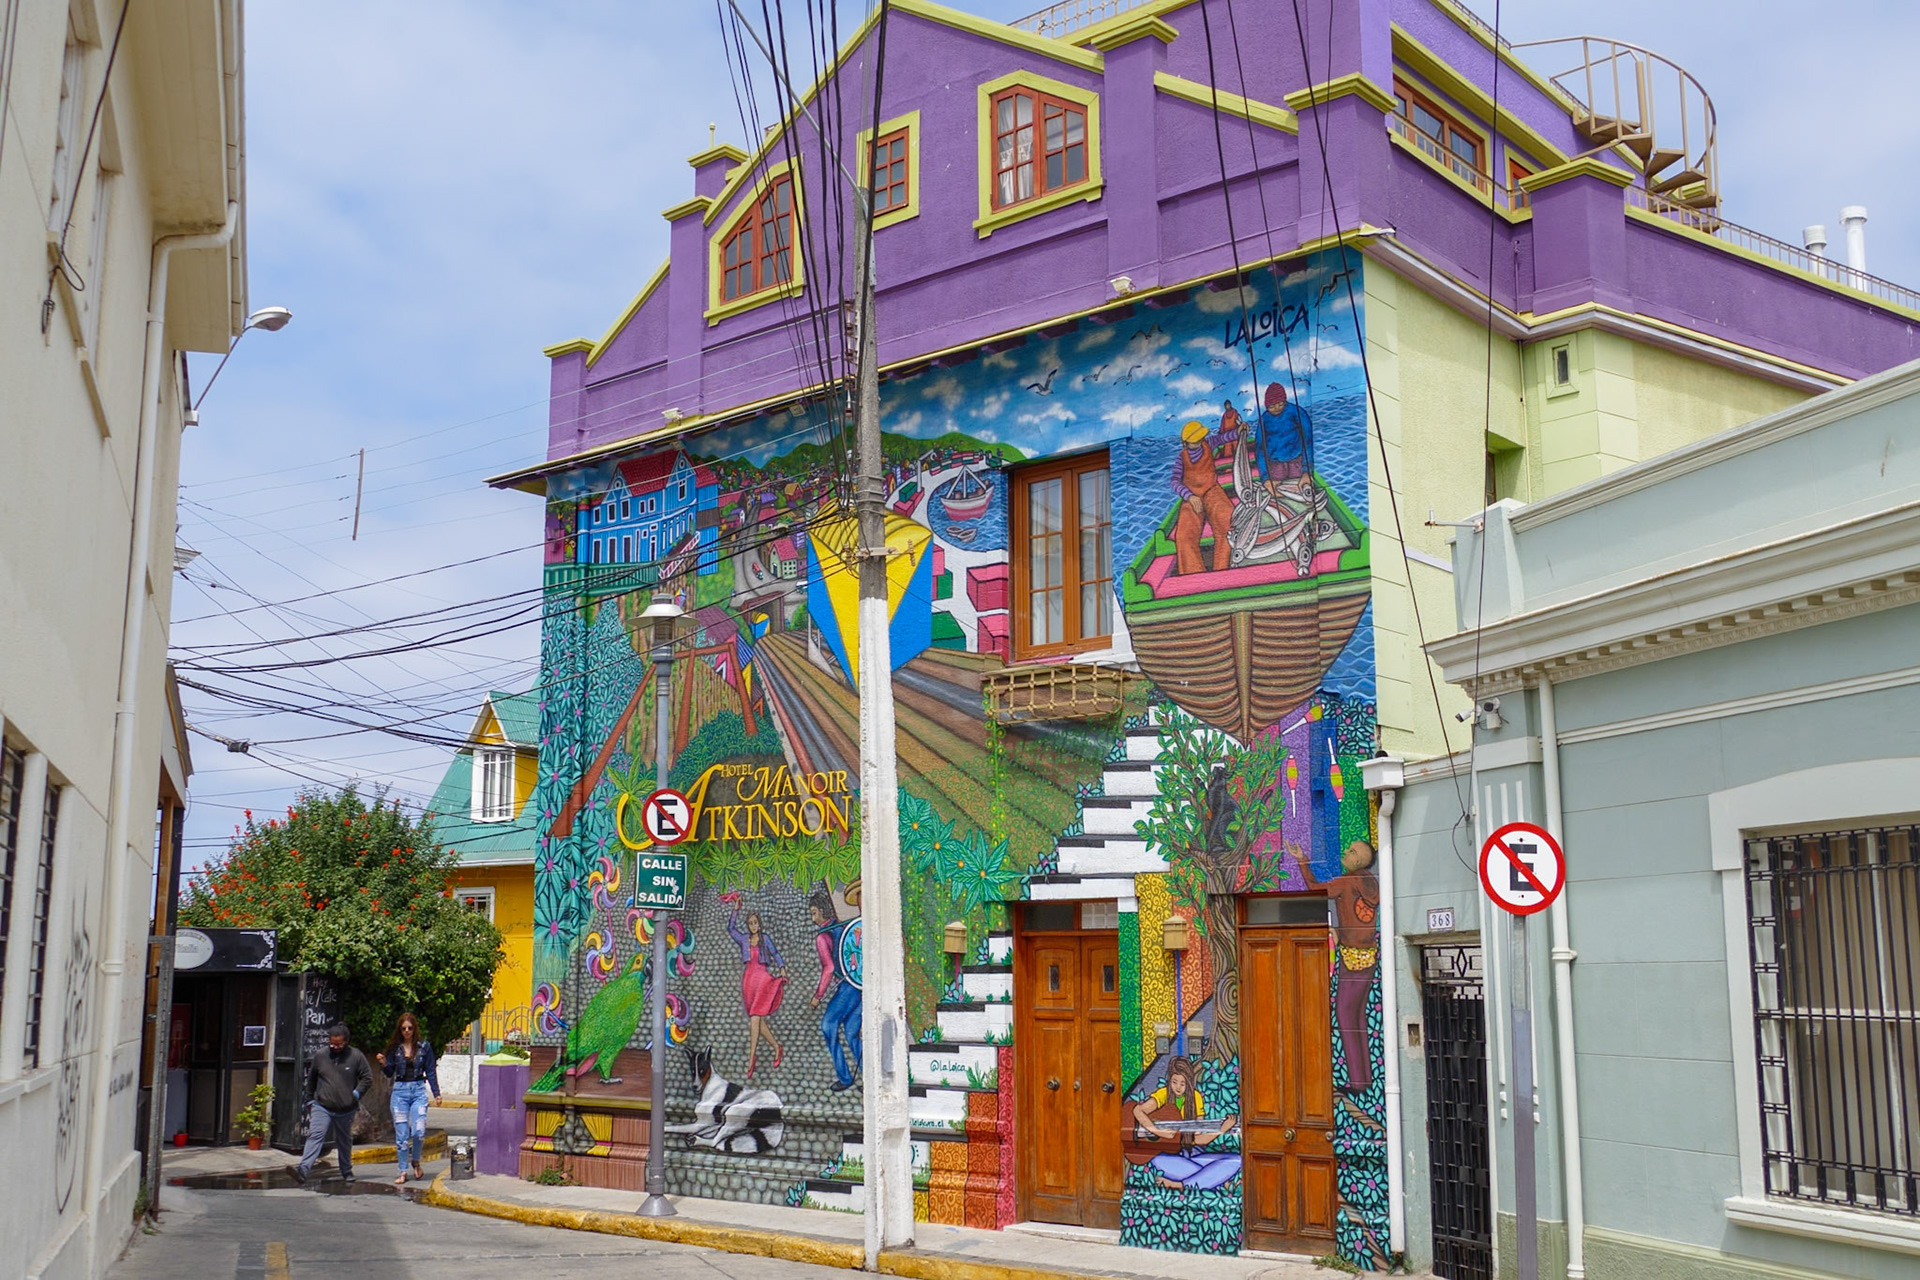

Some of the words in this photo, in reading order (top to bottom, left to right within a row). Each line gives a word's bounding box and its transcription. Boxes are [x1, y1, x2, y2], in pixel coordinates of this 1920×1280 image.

[721, 764, 754, 777] HOTEL
[737, 765, 849, 801] MANOIR
[641, 858, 683, 871] CALLE
[652, 875, 675, 888] SIN
[638, 892, 683, 905] SALIDA
[1431, 913, 1451, 927] 368
